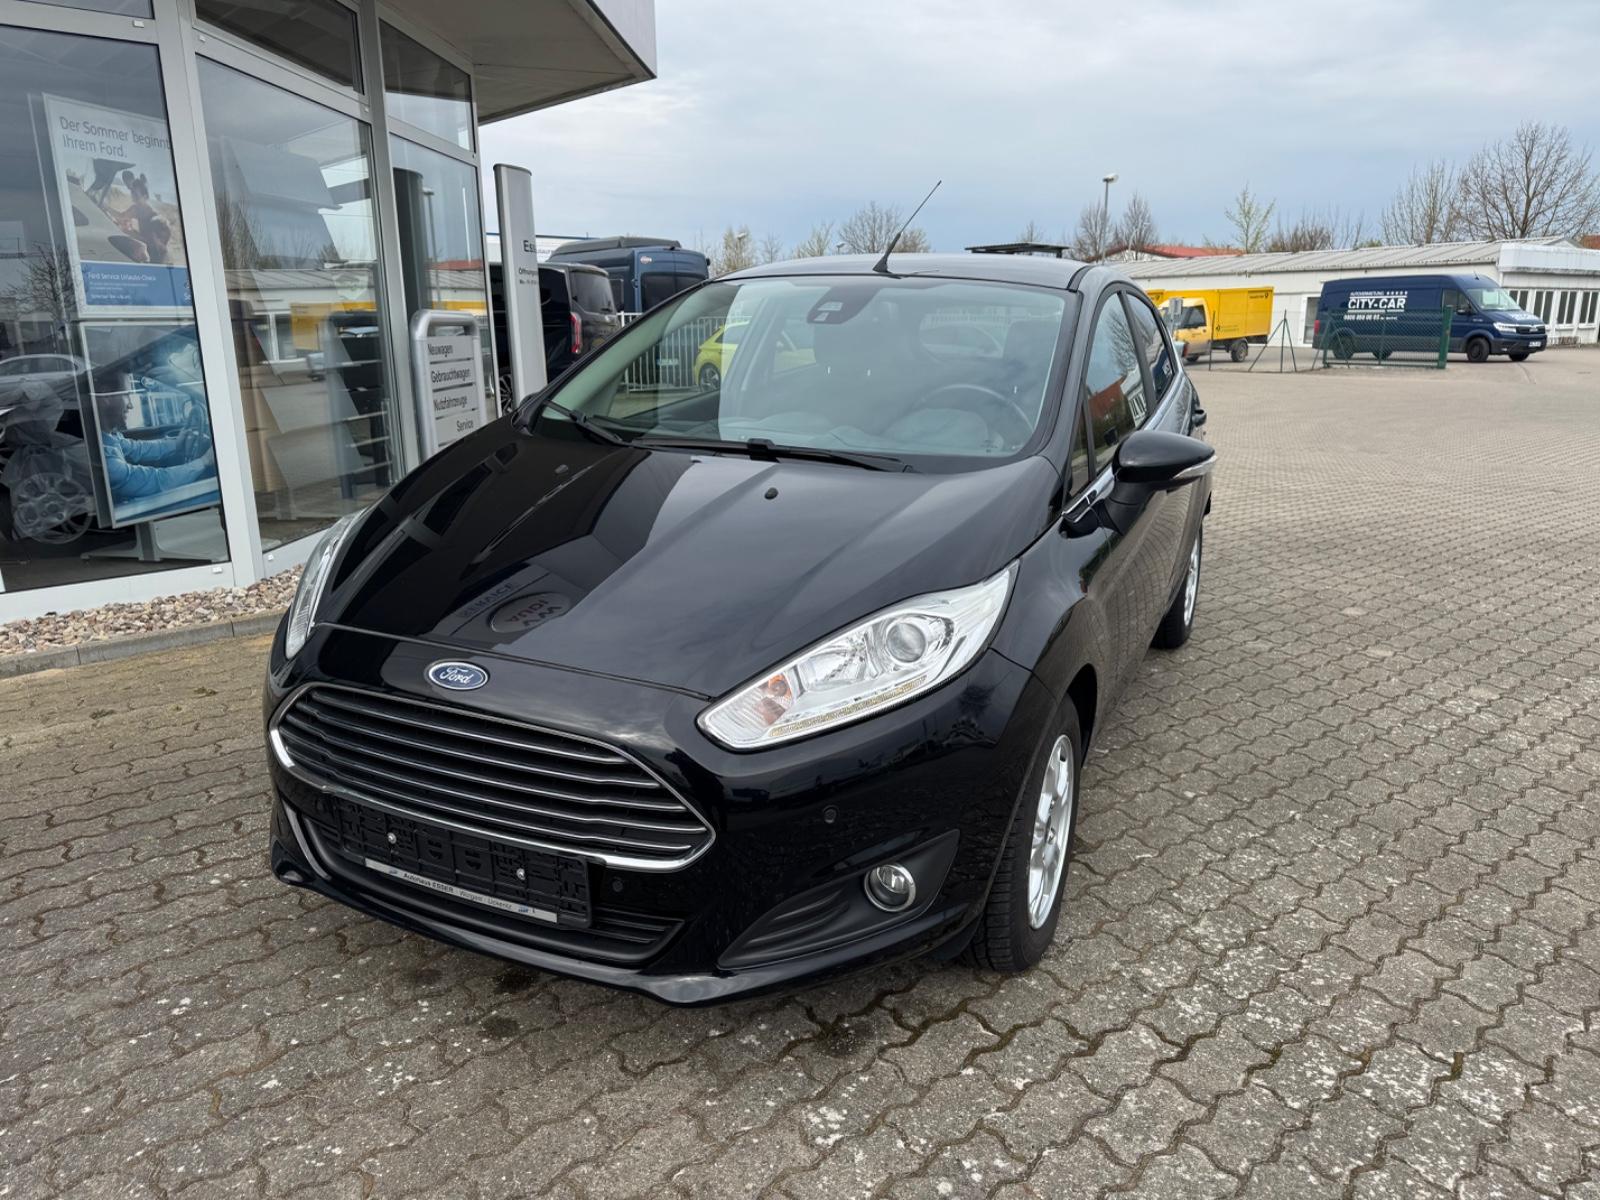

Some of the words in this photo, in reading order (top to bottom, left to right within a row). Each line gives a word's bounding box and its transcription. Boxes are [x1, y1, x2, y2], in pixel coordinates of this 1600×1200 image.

[60, 116, 80, 132] Der
[83, 121, 128, 141] Sommer
[132, 130, 170, 150] beginnt
[63, 135, 97, 153] Ihrem
[100, 142, 127, 158] Ford.
[1347, 298, 1406, 309] CITY-CAR
[428, 343, 453, 357] Neuwagen
[431, 368, 471, 383] Gebrauchtwagen
[433, 395, 467, 411] Nutzfahrzeuge
[456, 418, 474, 432] Service
[439, 666, 473, 685] Ford
[403, 872, 431, 887] Autohaus
[432, 882, 454, 893] ESSER
